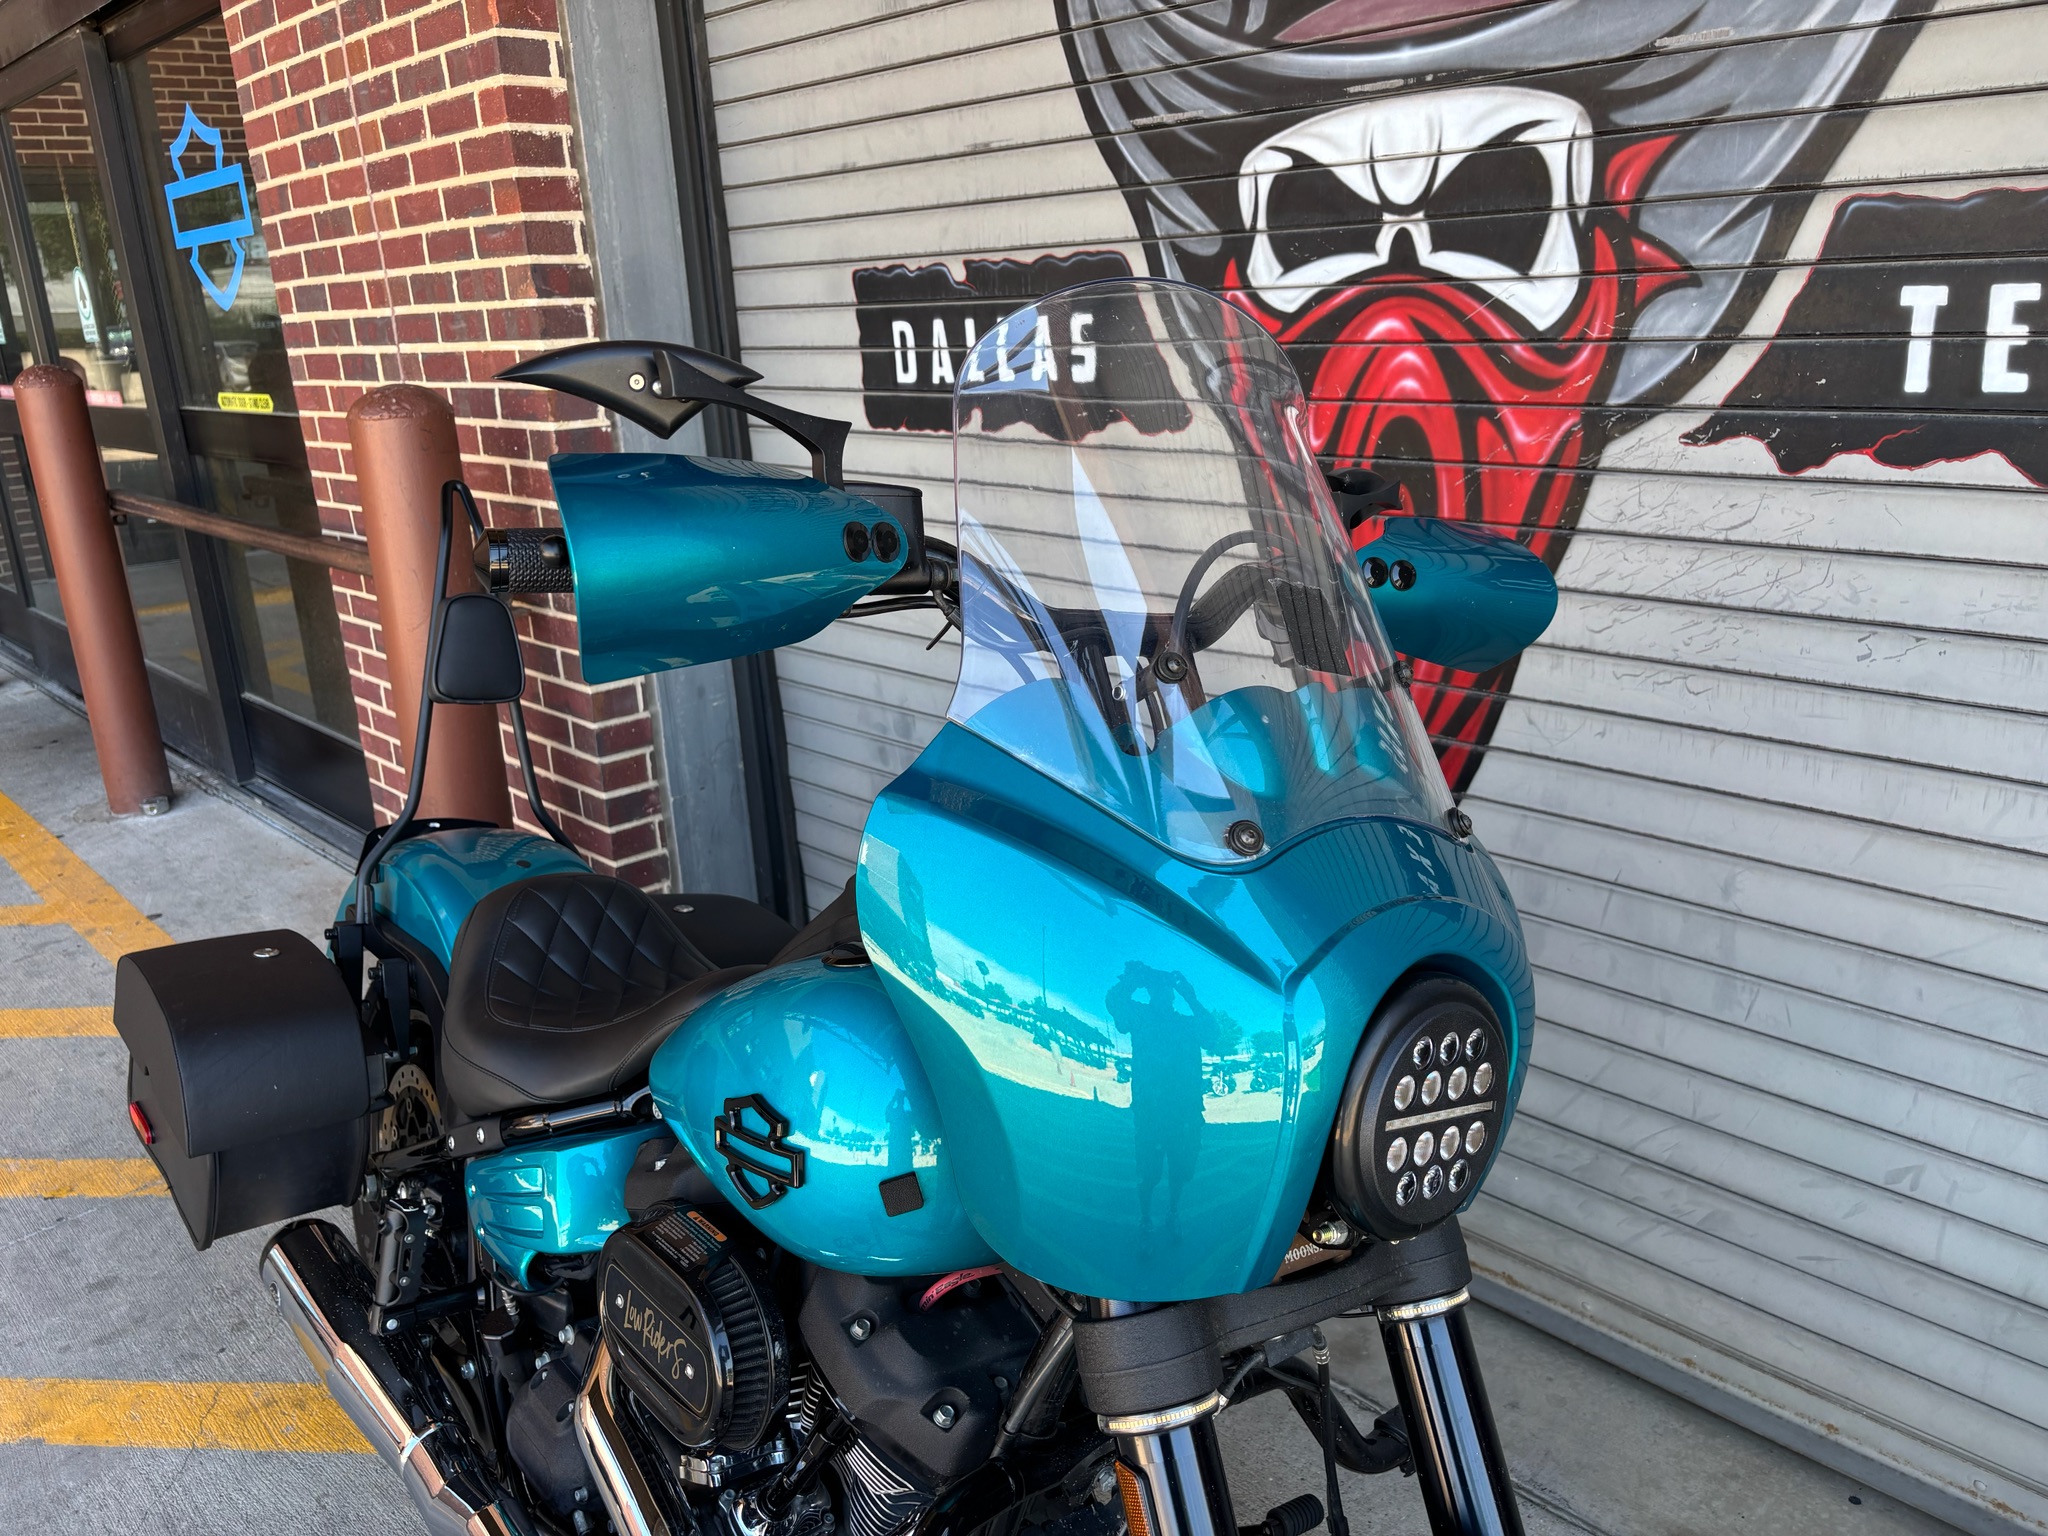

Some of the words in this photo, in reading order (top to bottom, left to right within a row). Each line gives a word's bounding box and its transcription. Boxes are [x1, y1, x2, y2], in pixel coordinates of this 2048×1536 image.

[891, 313, 1097, 385] DALLAS
[1284, 1243, 1323, 1264] MOONS
[935, 1272, 975, 1295] Eagle
